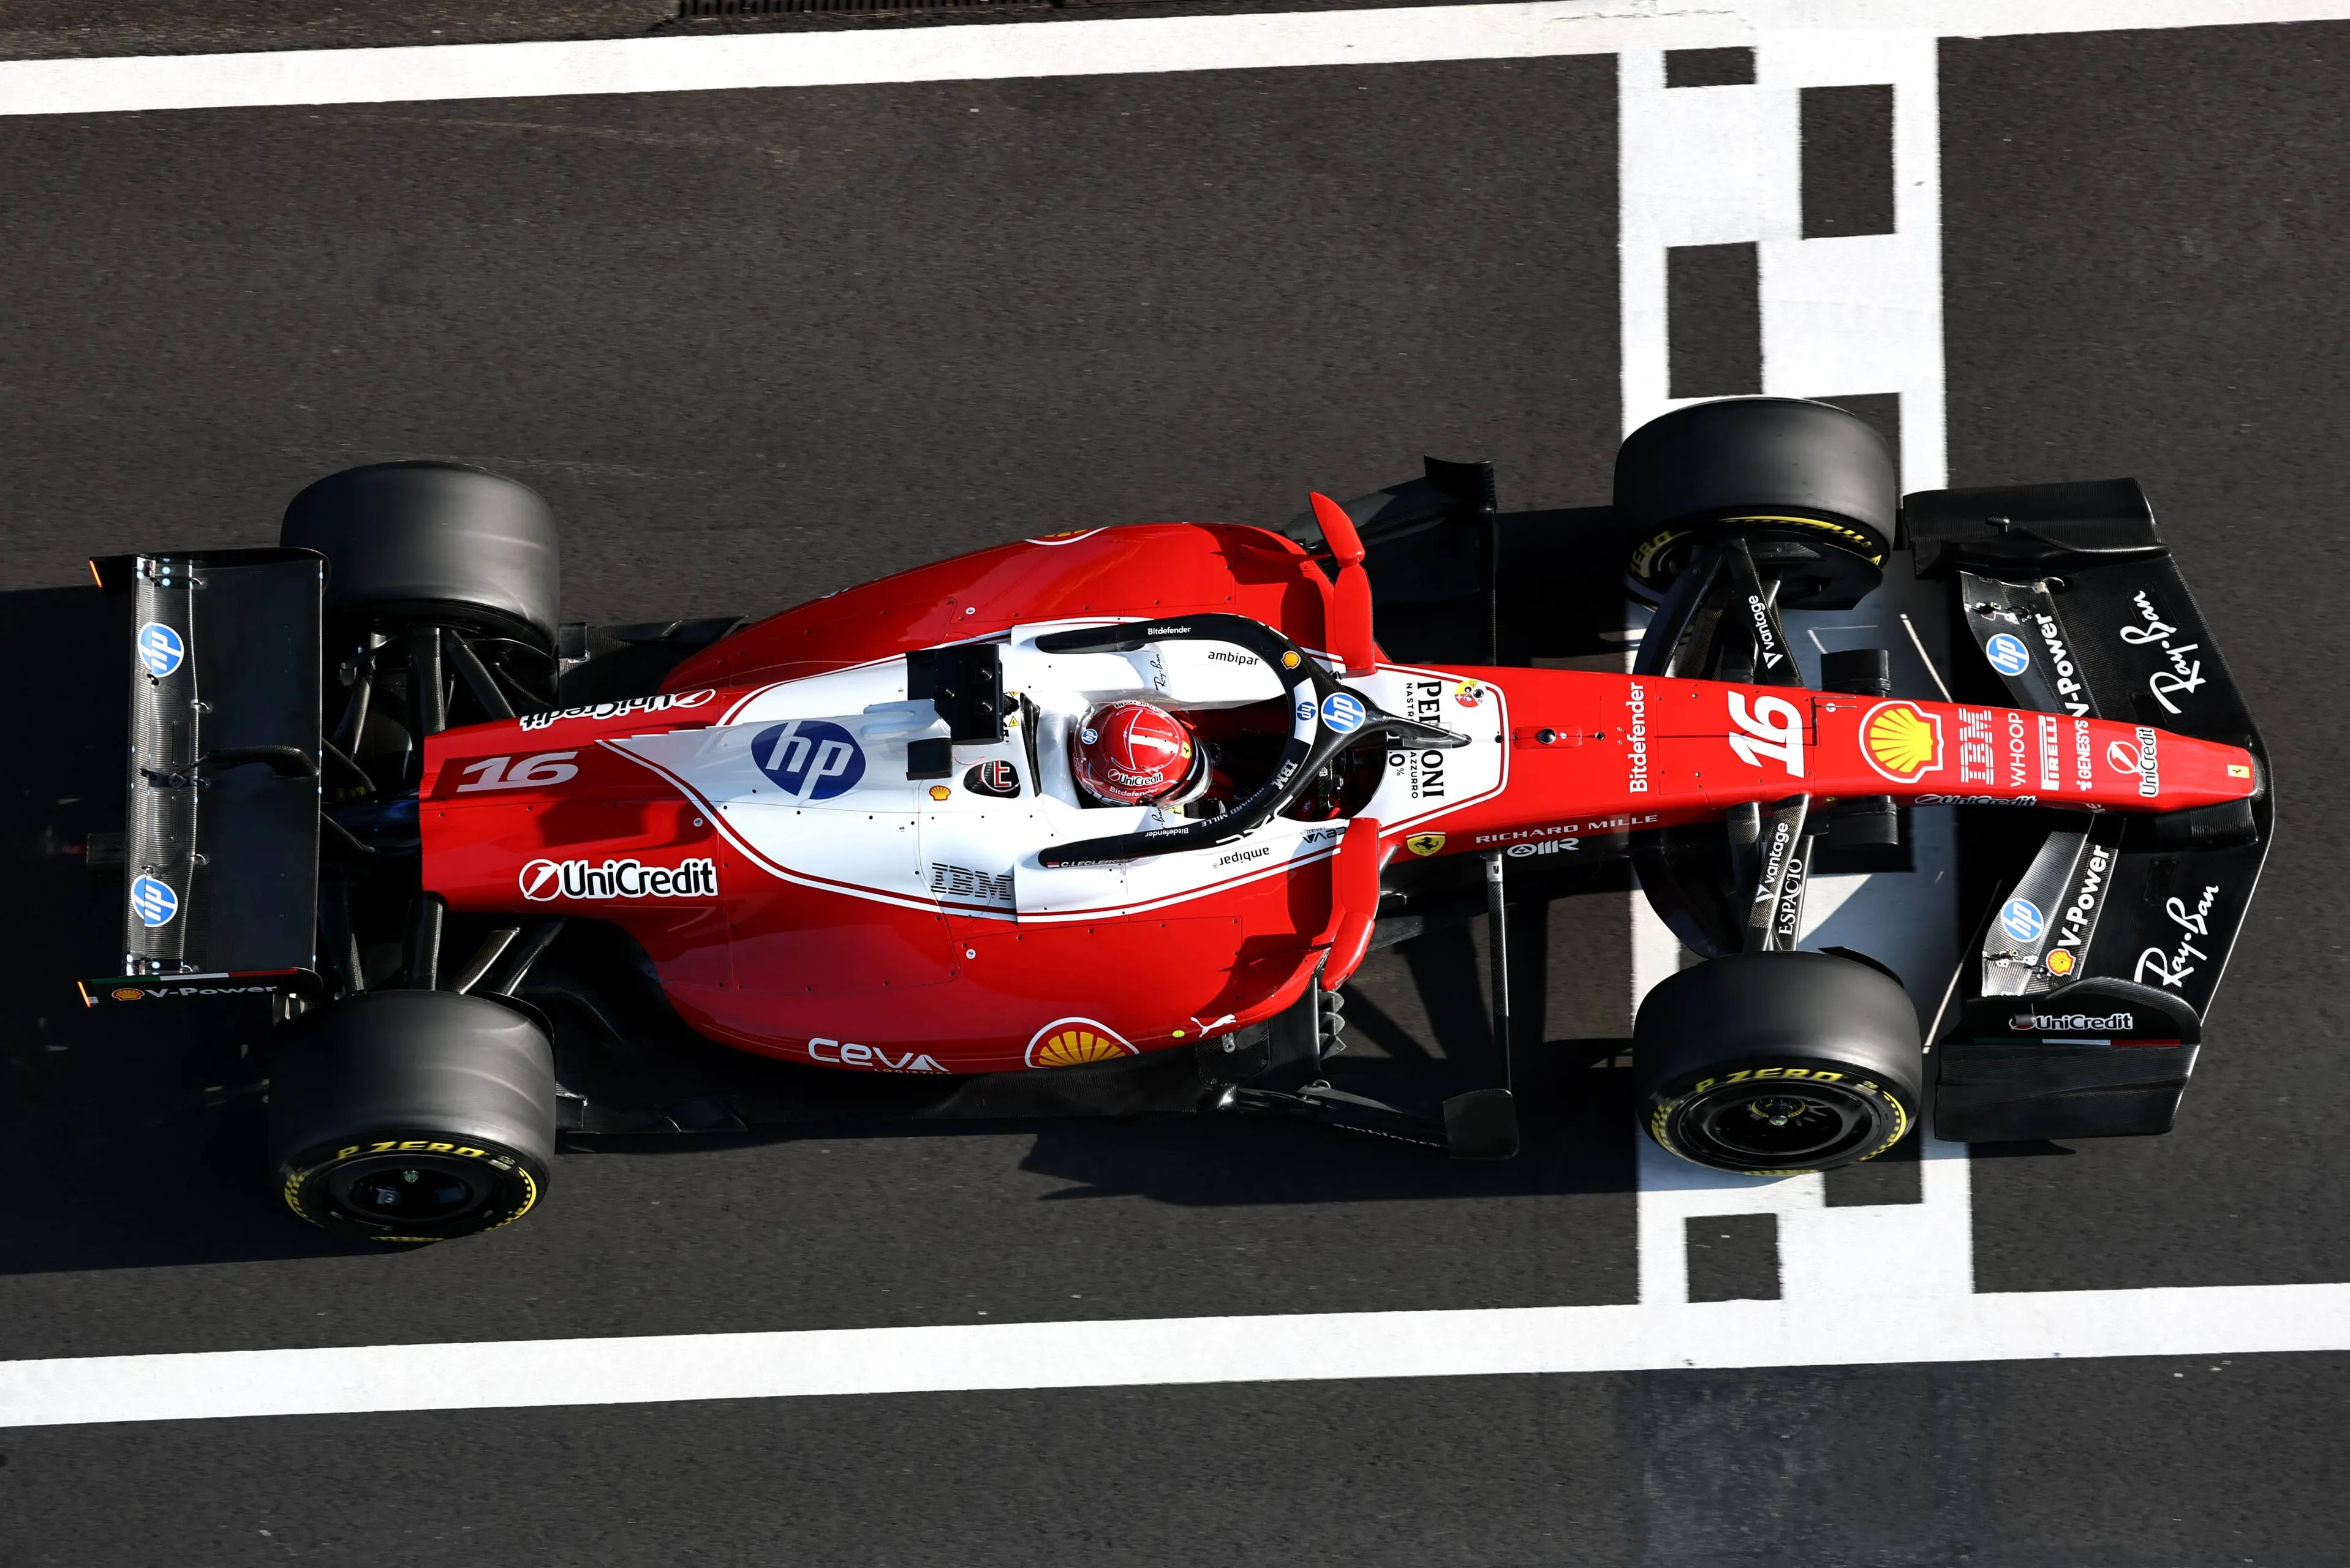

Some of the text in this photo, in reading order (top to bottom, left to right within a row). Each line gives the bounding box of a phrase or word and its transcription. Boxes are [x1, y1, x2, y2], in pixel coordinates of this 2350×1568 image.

[1147, 625, 1191, 635] Bitdefender
[1748, 594, 1775, 651] vantage
[138, 628, 184, 672] hp
[1207, 650, 1260, 666] ambipar
[1987, 637, 2028, 672] hp
[2035, 613, 2090, 717] V-Power
[523, 694, 673, 729] UniCredit
[1297, 703, 1317, 720] hp
[1322, 695, 1366, 729] hp
[1082, 729, 1097, 744] hp
[1406, 682, 1418, 799] NASTR AZZURRO
[1625, 681, 1648, 794] Bitdefender
[1728, 690, 1805, 778] 16
[1959, 707, 1995, 785] IBM
[2008, 712, 2027, 787] WHOOP
[2038, 714, 2060, 791] PIRELLI
[2074, 719, 2092, 780] GENESYS
[456, 751, 579, 793] 16
[763, 721, 856, 799] hp
[1271, 760, 1299, 790] IBM
[2137, 727, 2158, 796] UniCredit
[1109, 786, 1159, 797] Bitdefender
[1119, 772, 1163, 786] UniCredit
[1941, 796, 2038, 806] UniCredit
[1145, 827, 1190, 838] Bitdefender
[1201, 813, 1228, 827] MILLE
[1476, 815, 1657, 843] RICHARD MILLE
[1218, 846, 1271, 866] ambipar
[1764, 822, 1789, 884] vantage
[563, 859, 716, 897] UniCredit
[931, 862, 1014, 900] IBM
[2057, 845, 2110, 947] V-Power
[131, 883, 178, 922] hp
[1778, 858, 1802, 936] ESPACIO
[2001, 901, 2044, 938] hp
[145, 986, 278, 998] V-Power
[2036, 1012, 2133, 1031] UniCredit
[1694, 1067, 1845, 1093] P ZERO
[337, 1140, 488, 1159] P ZERO
